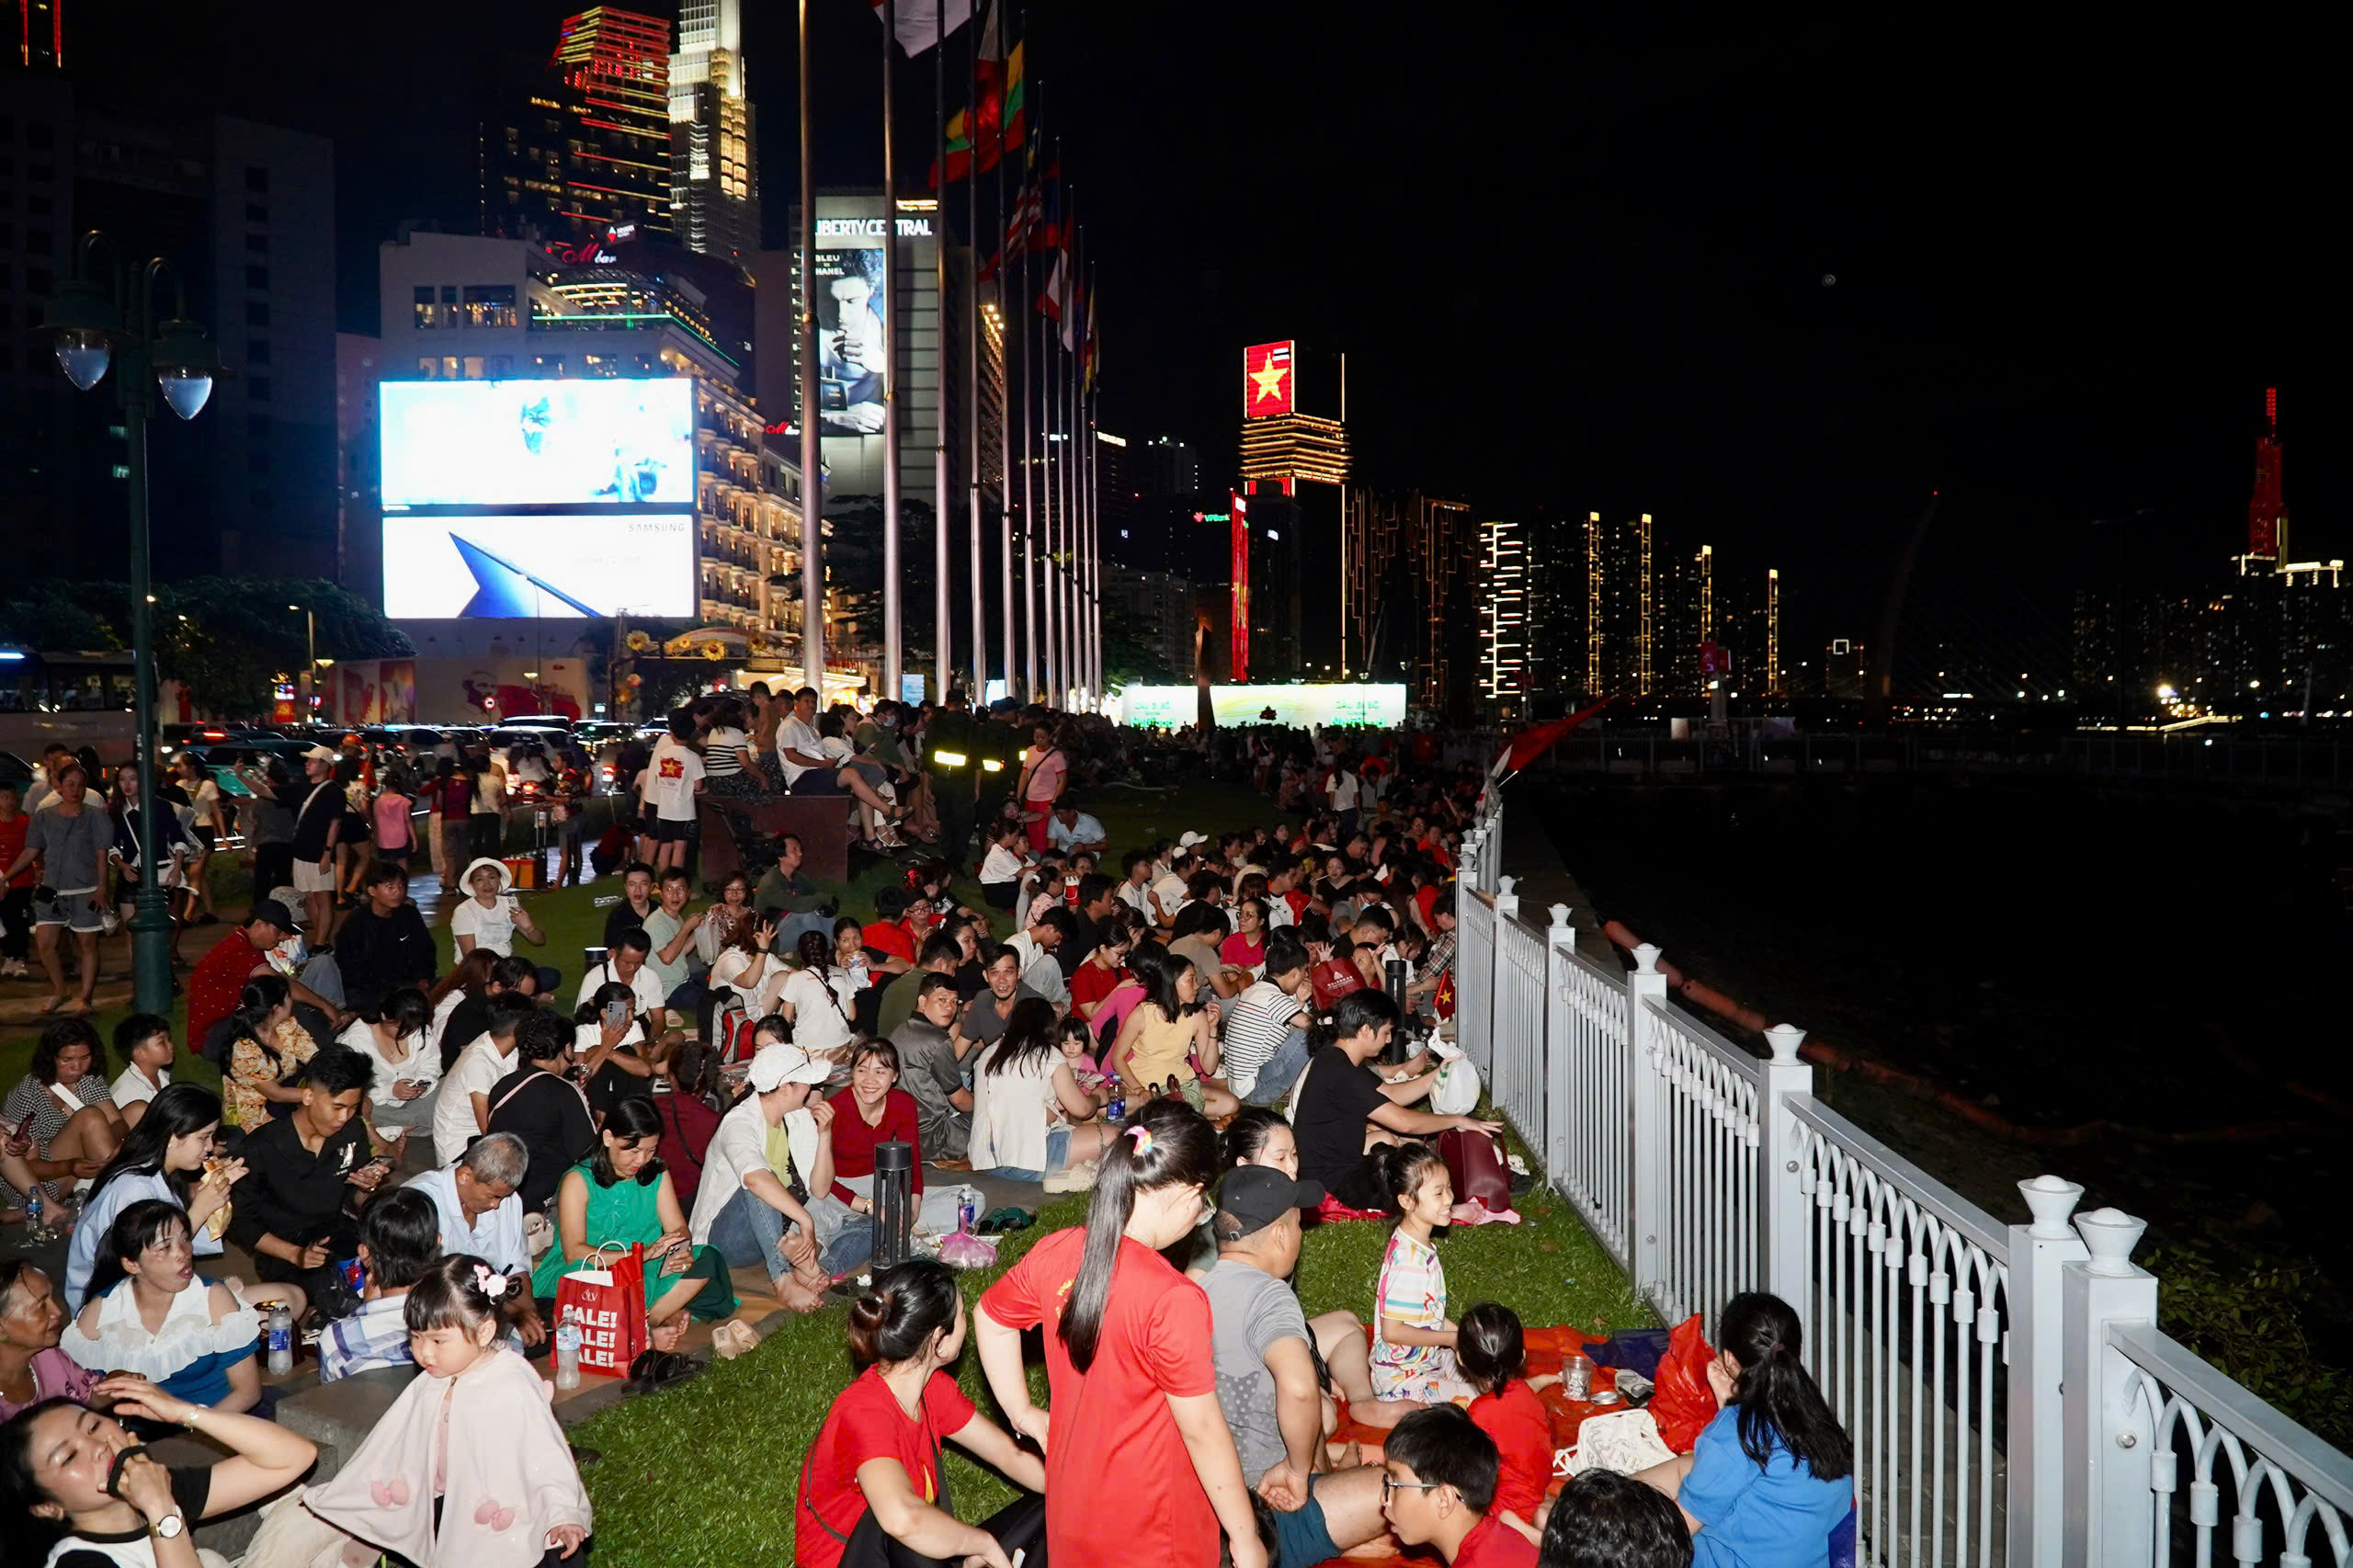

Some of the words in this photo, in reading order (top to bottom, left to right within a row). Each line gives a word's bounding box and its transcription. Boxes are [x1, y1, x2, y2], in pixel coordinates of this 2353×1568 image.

[815, 220, 866, 235] IBERTY
[866, 220, 933, 235] CETRAL
[815, 267, 845, 276] HANEL
[629, 522, 685, 532] SAMSUNG
